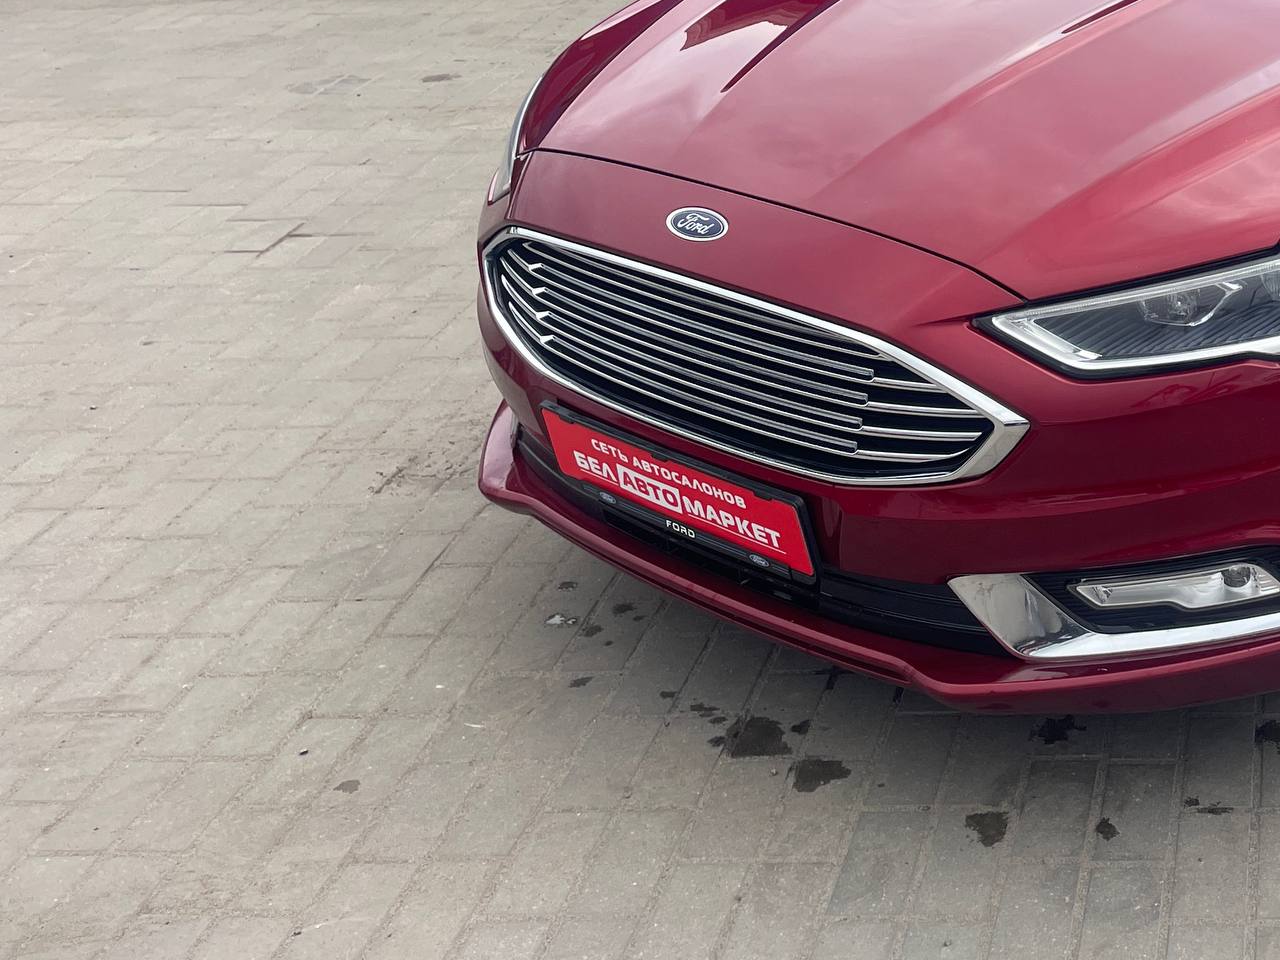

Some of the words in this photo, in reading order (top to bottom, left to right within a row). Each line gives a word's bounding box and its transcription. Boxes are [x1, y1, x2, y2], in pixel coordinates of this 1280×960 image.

[676, 212, 715, 235] Ford
[591, 438, 628, 463] СЕТЬ
[633, 456, 747, 510] АВТОСАЛОНОВ
[573, 450, 617, 482] БЕЛ
[622, 471, 682, 511] АВТО
[682, 495, 781, 549] МАРКЕТ
[665, 519, 696, 539] FORD
